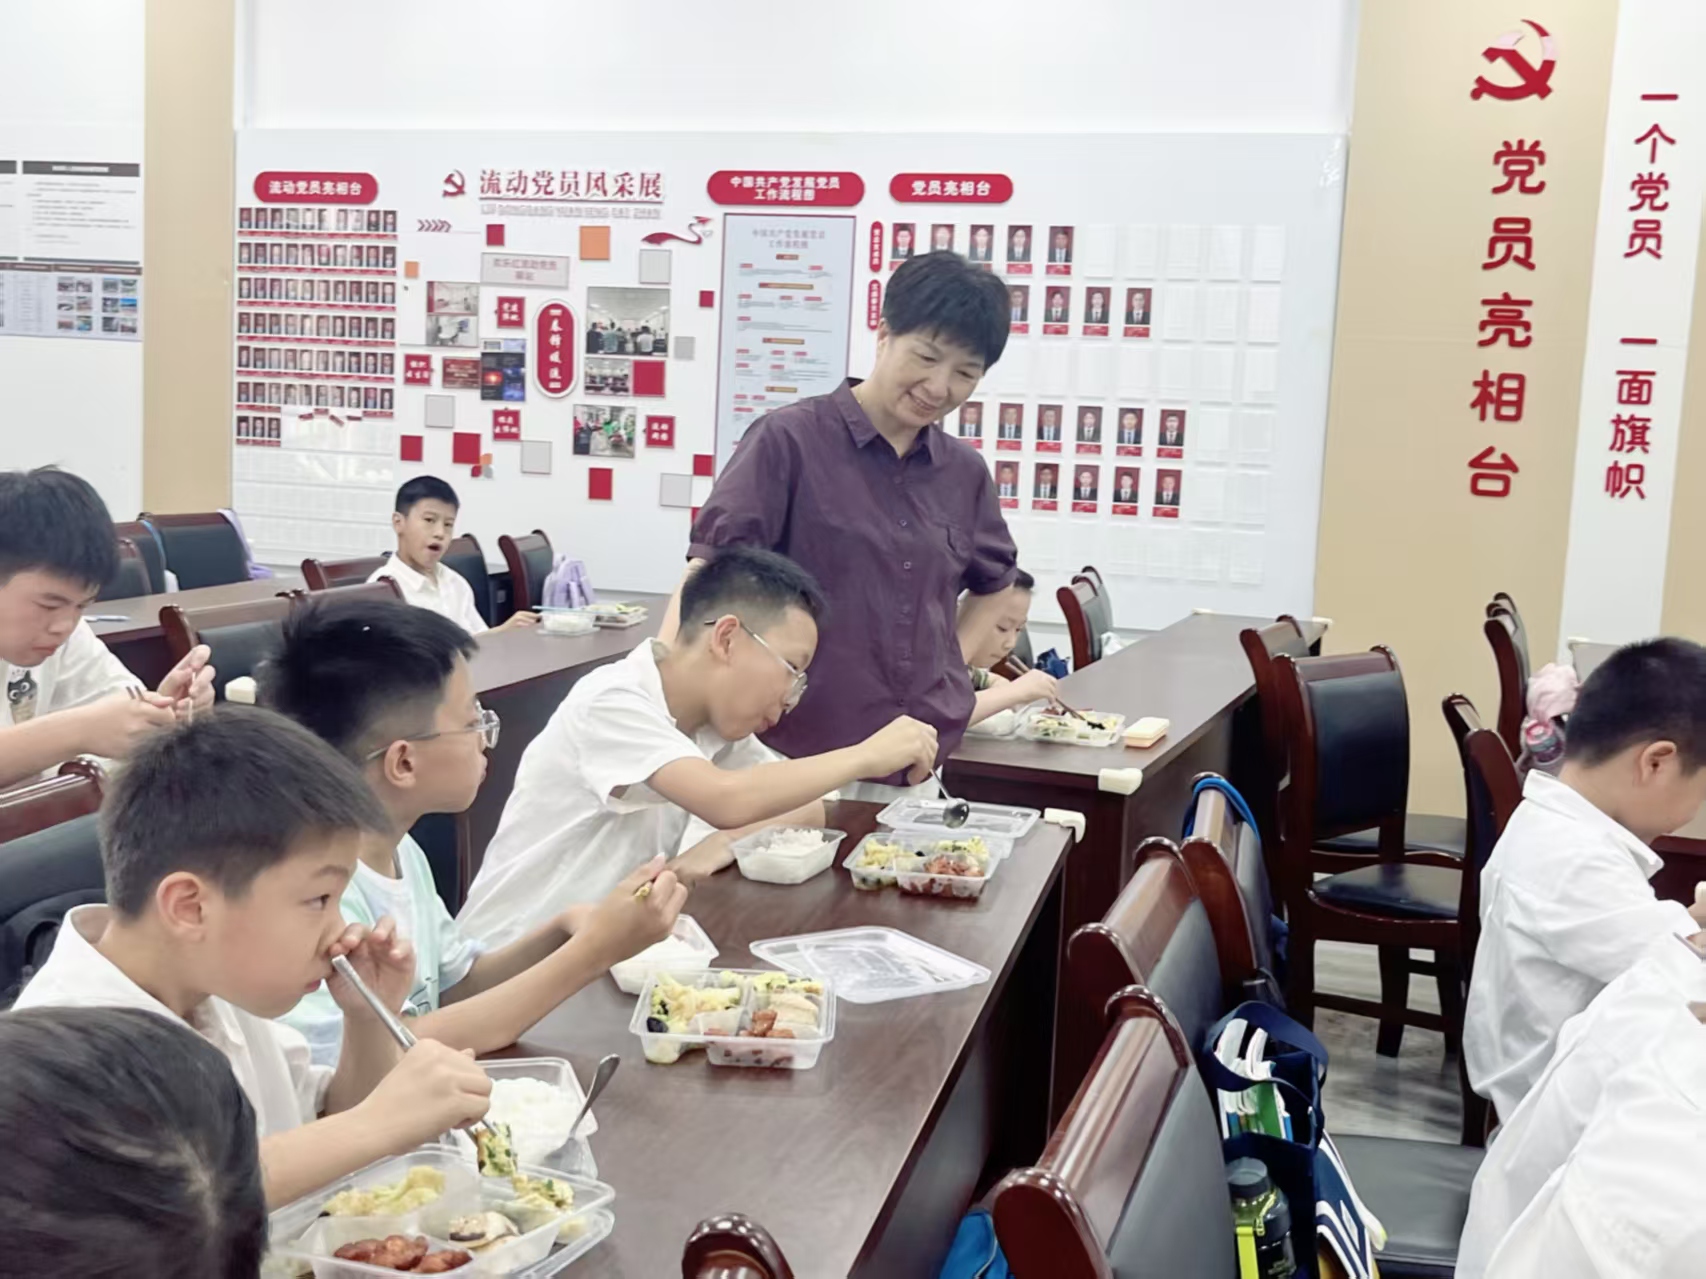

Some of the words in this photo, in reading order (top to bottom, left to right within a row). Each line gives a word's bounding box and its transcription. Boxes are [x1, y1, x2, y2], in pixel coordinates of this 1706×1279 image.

[268, 180, 363, 196] 流动党员亮相台
[479, 168, 662, 198] 流动党员风采展
[910, 179, 992, 197] 党员亮相台
[1623, 93, 1679, 260] 一个党员
[1467, 138, 1547, 499] 党员亮相台
[1604, 337, 1657, 500] 一面旗帜
